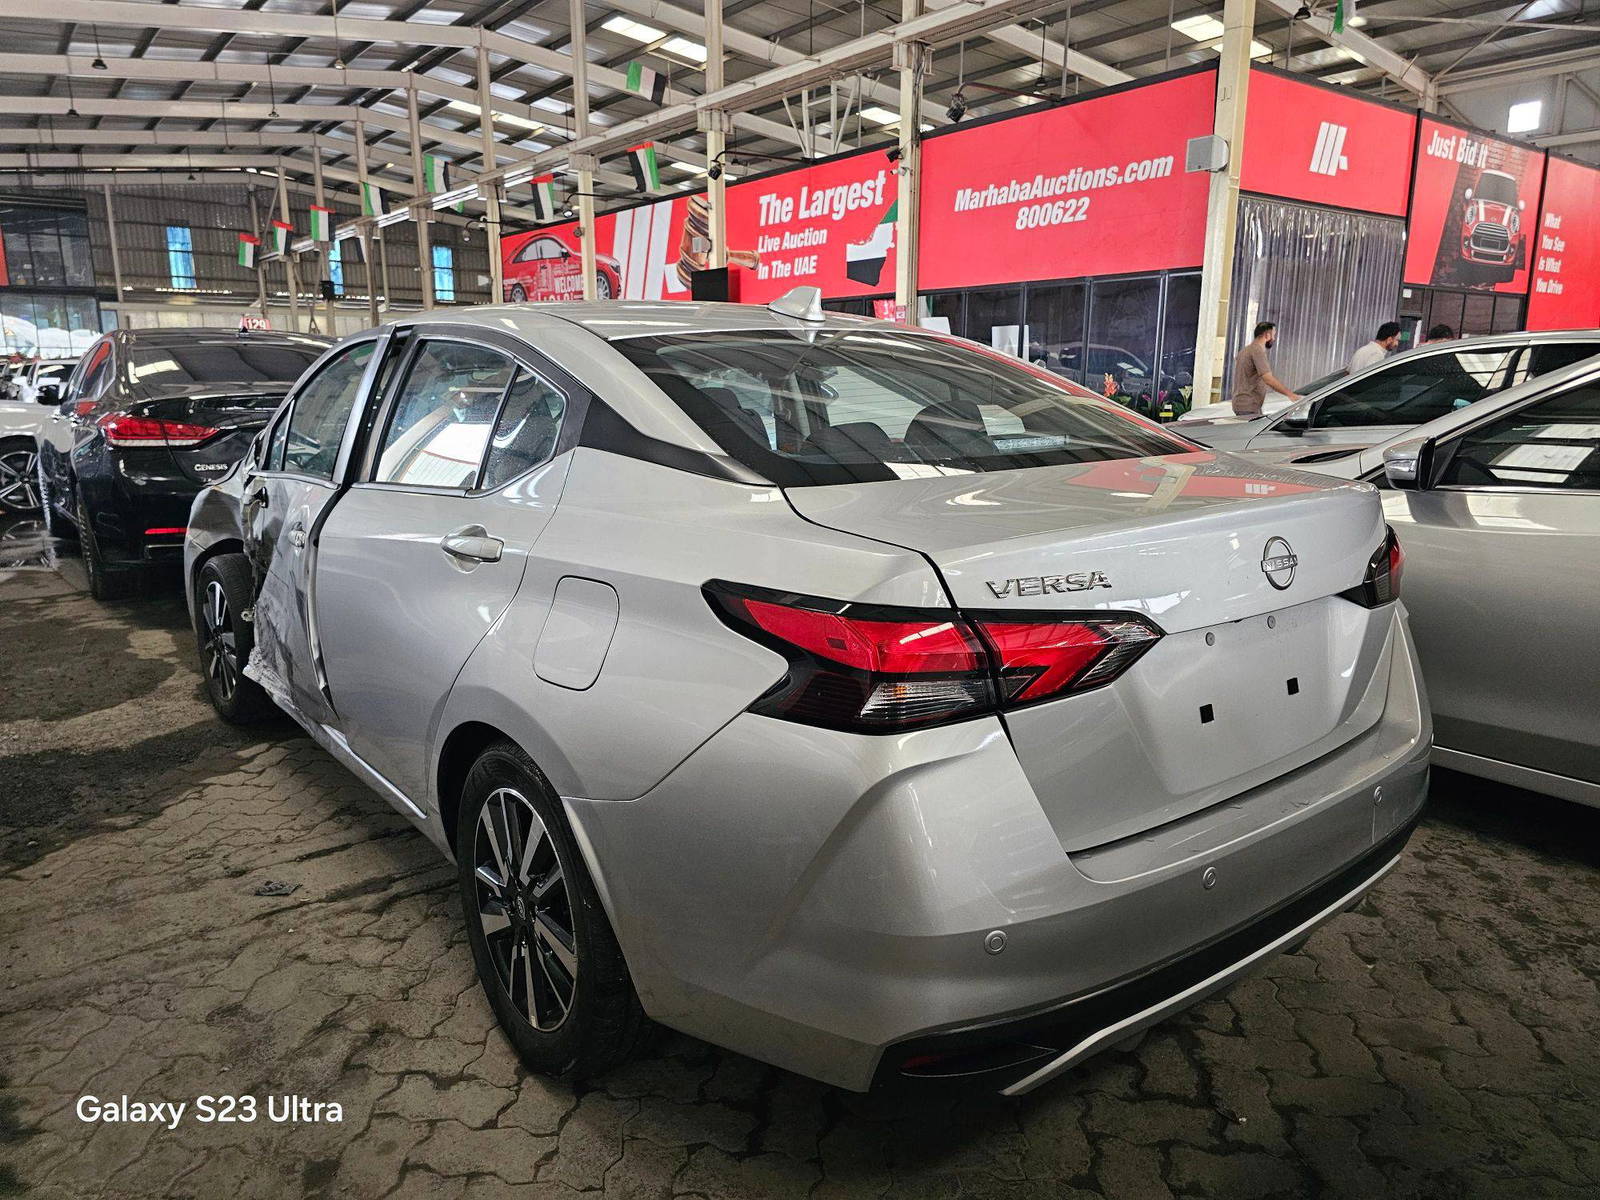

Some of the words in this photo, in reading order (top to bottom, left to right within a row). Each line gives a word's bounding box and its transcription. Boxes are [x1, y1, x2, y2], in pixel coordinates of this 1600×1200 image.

[1427, 129, 1457, 160] Just
[1456, 137, 1478, 166] Bid
[1477, 143, 1488, 168] It
[954, 155, 1174, 212] MarhabaAuctions.com
[759, 193, 793, 226] The
[798, 170, 886, 220] Largest
[1015, 196, 1090, 230] 800622
[1544, 213, 1562, 229] What
[758, 235, 783, 253] Live
[781, 226, 828, 250] Auction
[1541, 234, 1554, 250] You
[1552, 236, 1566, 252] See
[757, 262, 769, 280] In
[771, 260, 792, 279] The
[793, 255, 818, 276] UAE
[1538, 256, 1546, 271] Is
[1544, 257, 1562, 273] What
[1535, 277, 1548, 292] You
[248, 319, 266, 330] 129
[194, 463, 228, 472] GENESIS
[984, 570, 1112, 599] VERSA
